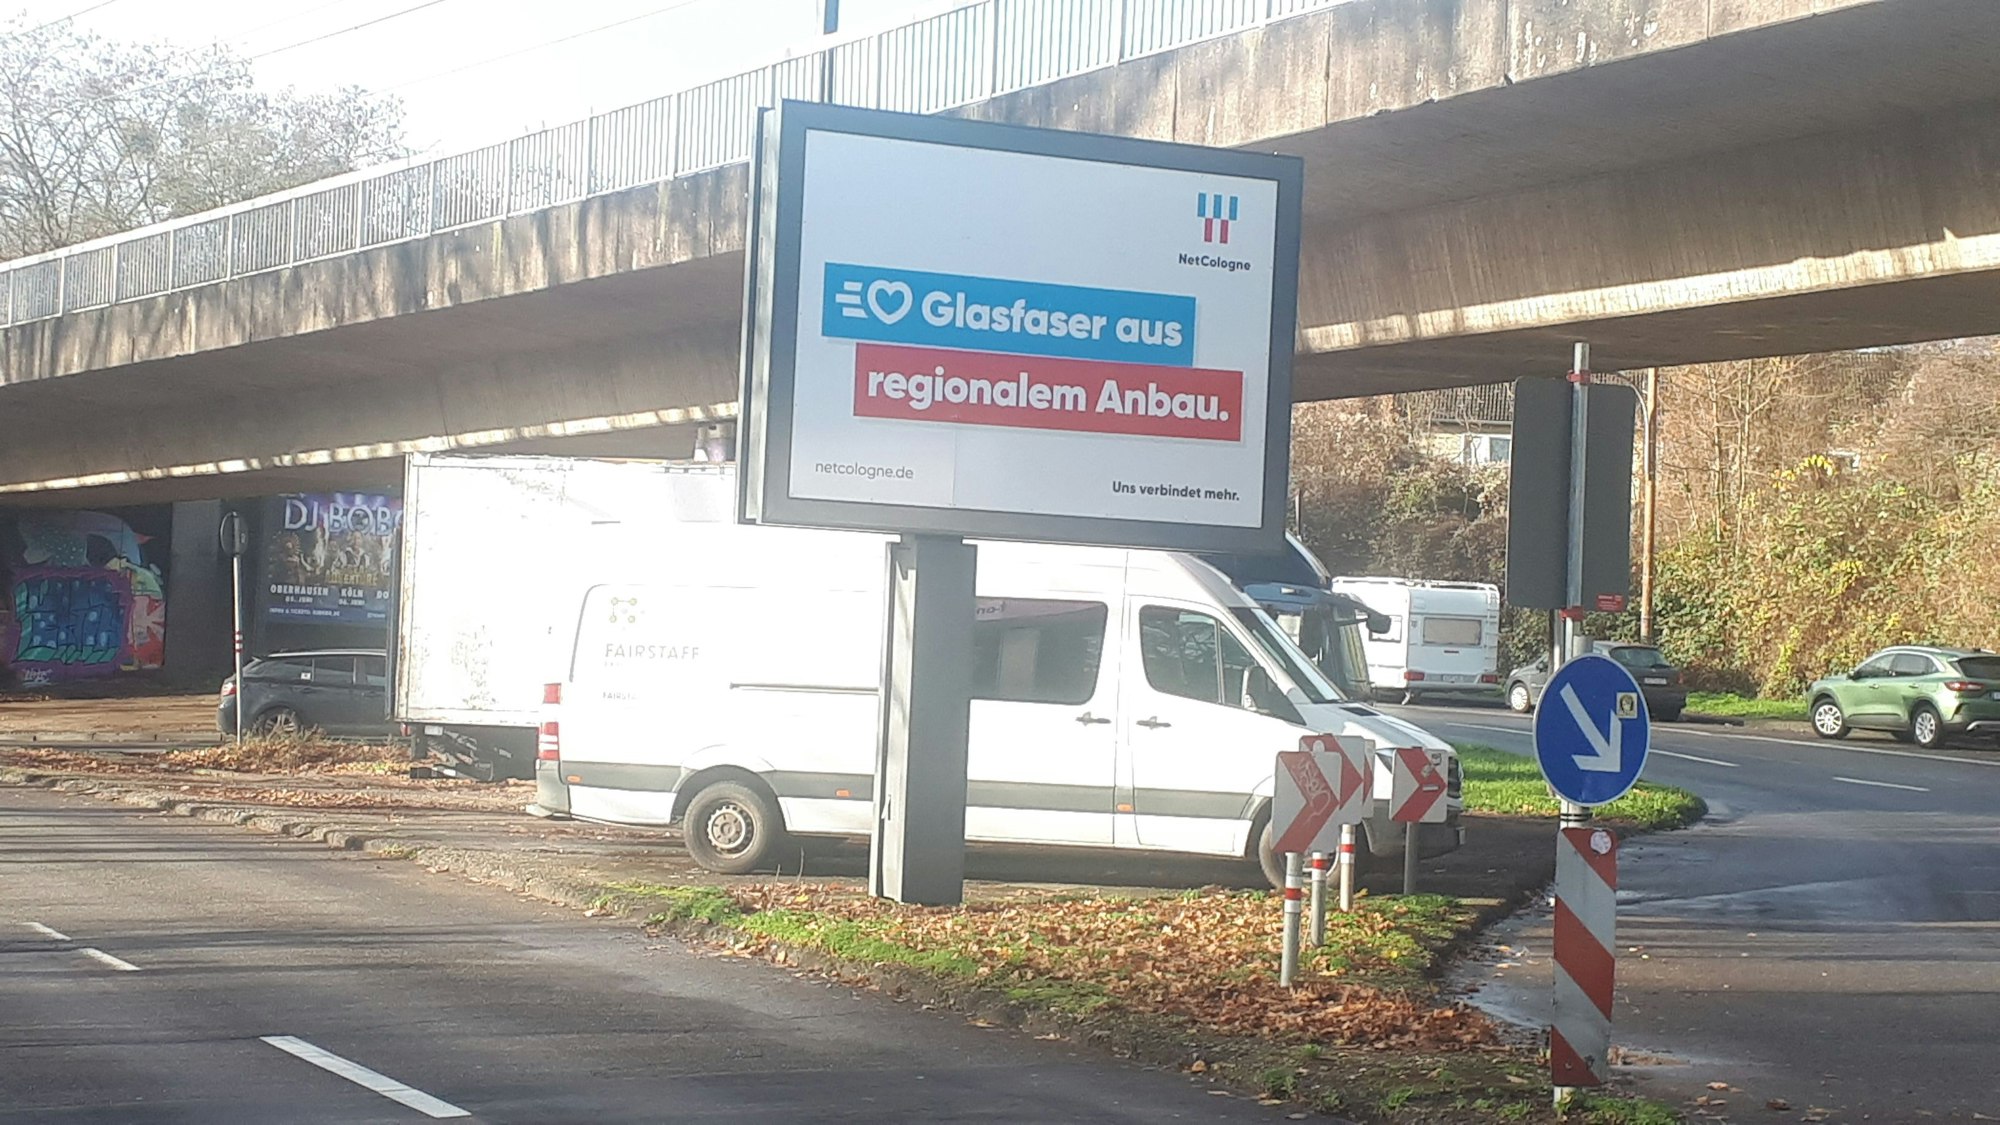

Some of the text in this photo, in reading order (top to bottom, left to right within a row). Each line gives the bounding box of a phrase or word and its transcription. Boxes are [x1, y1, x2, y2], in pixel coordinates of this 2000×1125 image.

[1178, 253, 1251, 272] NetCologne
[921, 291, 1183, 346] Glasfaser aus
[867, 366, 1230, 422] regionalem Anbau.
[815, 462, 914, 480] netcologne.de
[1112, 481, 1240, 501] Uns verbindet mehr.
[284, 499, 319, 531] DJ
[270, 584, 329, 596] OBERHAUSEN
[341, 586, 364, 598] KÖLN
[605, 643, 700, 660] FAIRSTAFF
